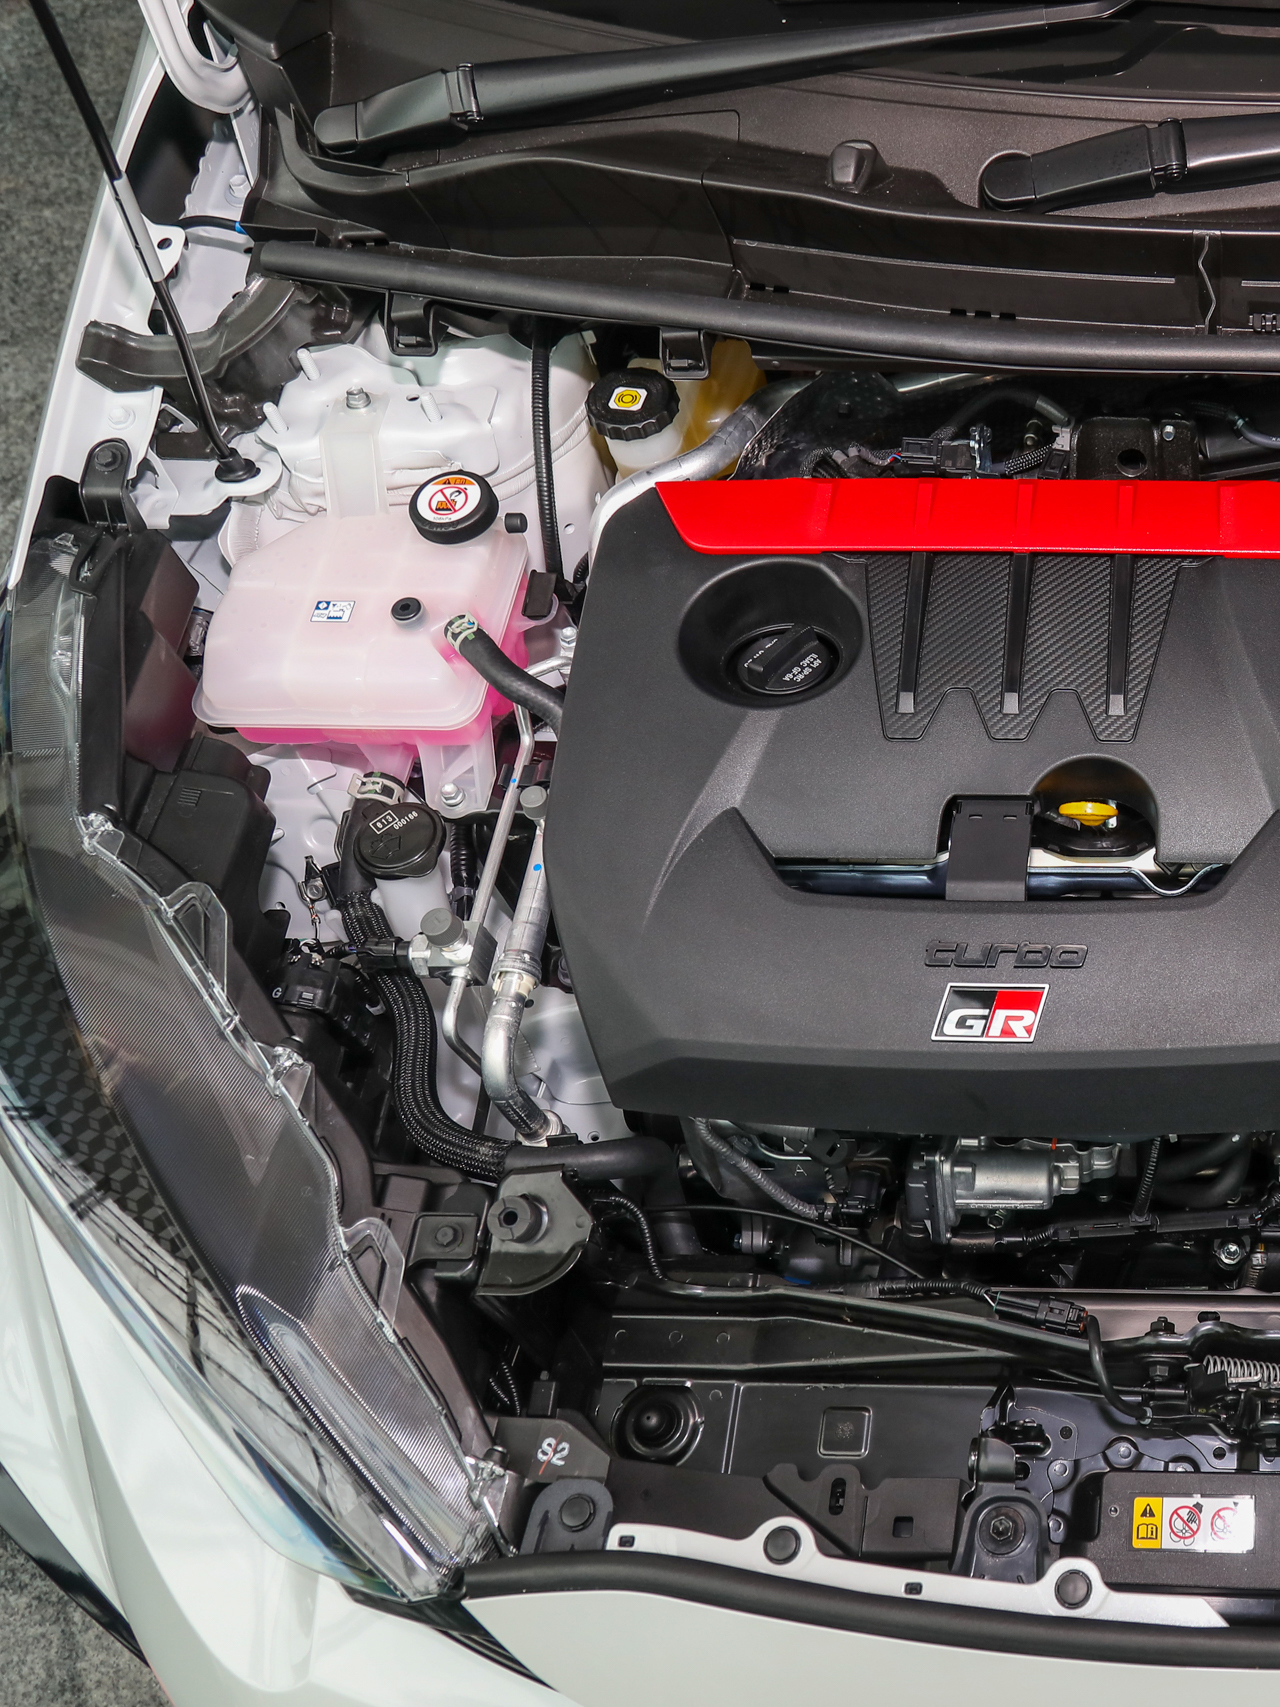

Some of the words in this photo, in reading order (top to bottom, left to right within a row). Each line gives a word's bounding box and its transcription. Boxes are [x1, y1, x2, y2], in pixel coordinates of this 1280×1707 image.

[924, 940, 1089, 969] turbo
[271, 986, 282, 999] G
[943, 1008, 1036, 1037] GR
[794, 1164, 808, 1177] A
[537, 1437, 570, 1466] S2
